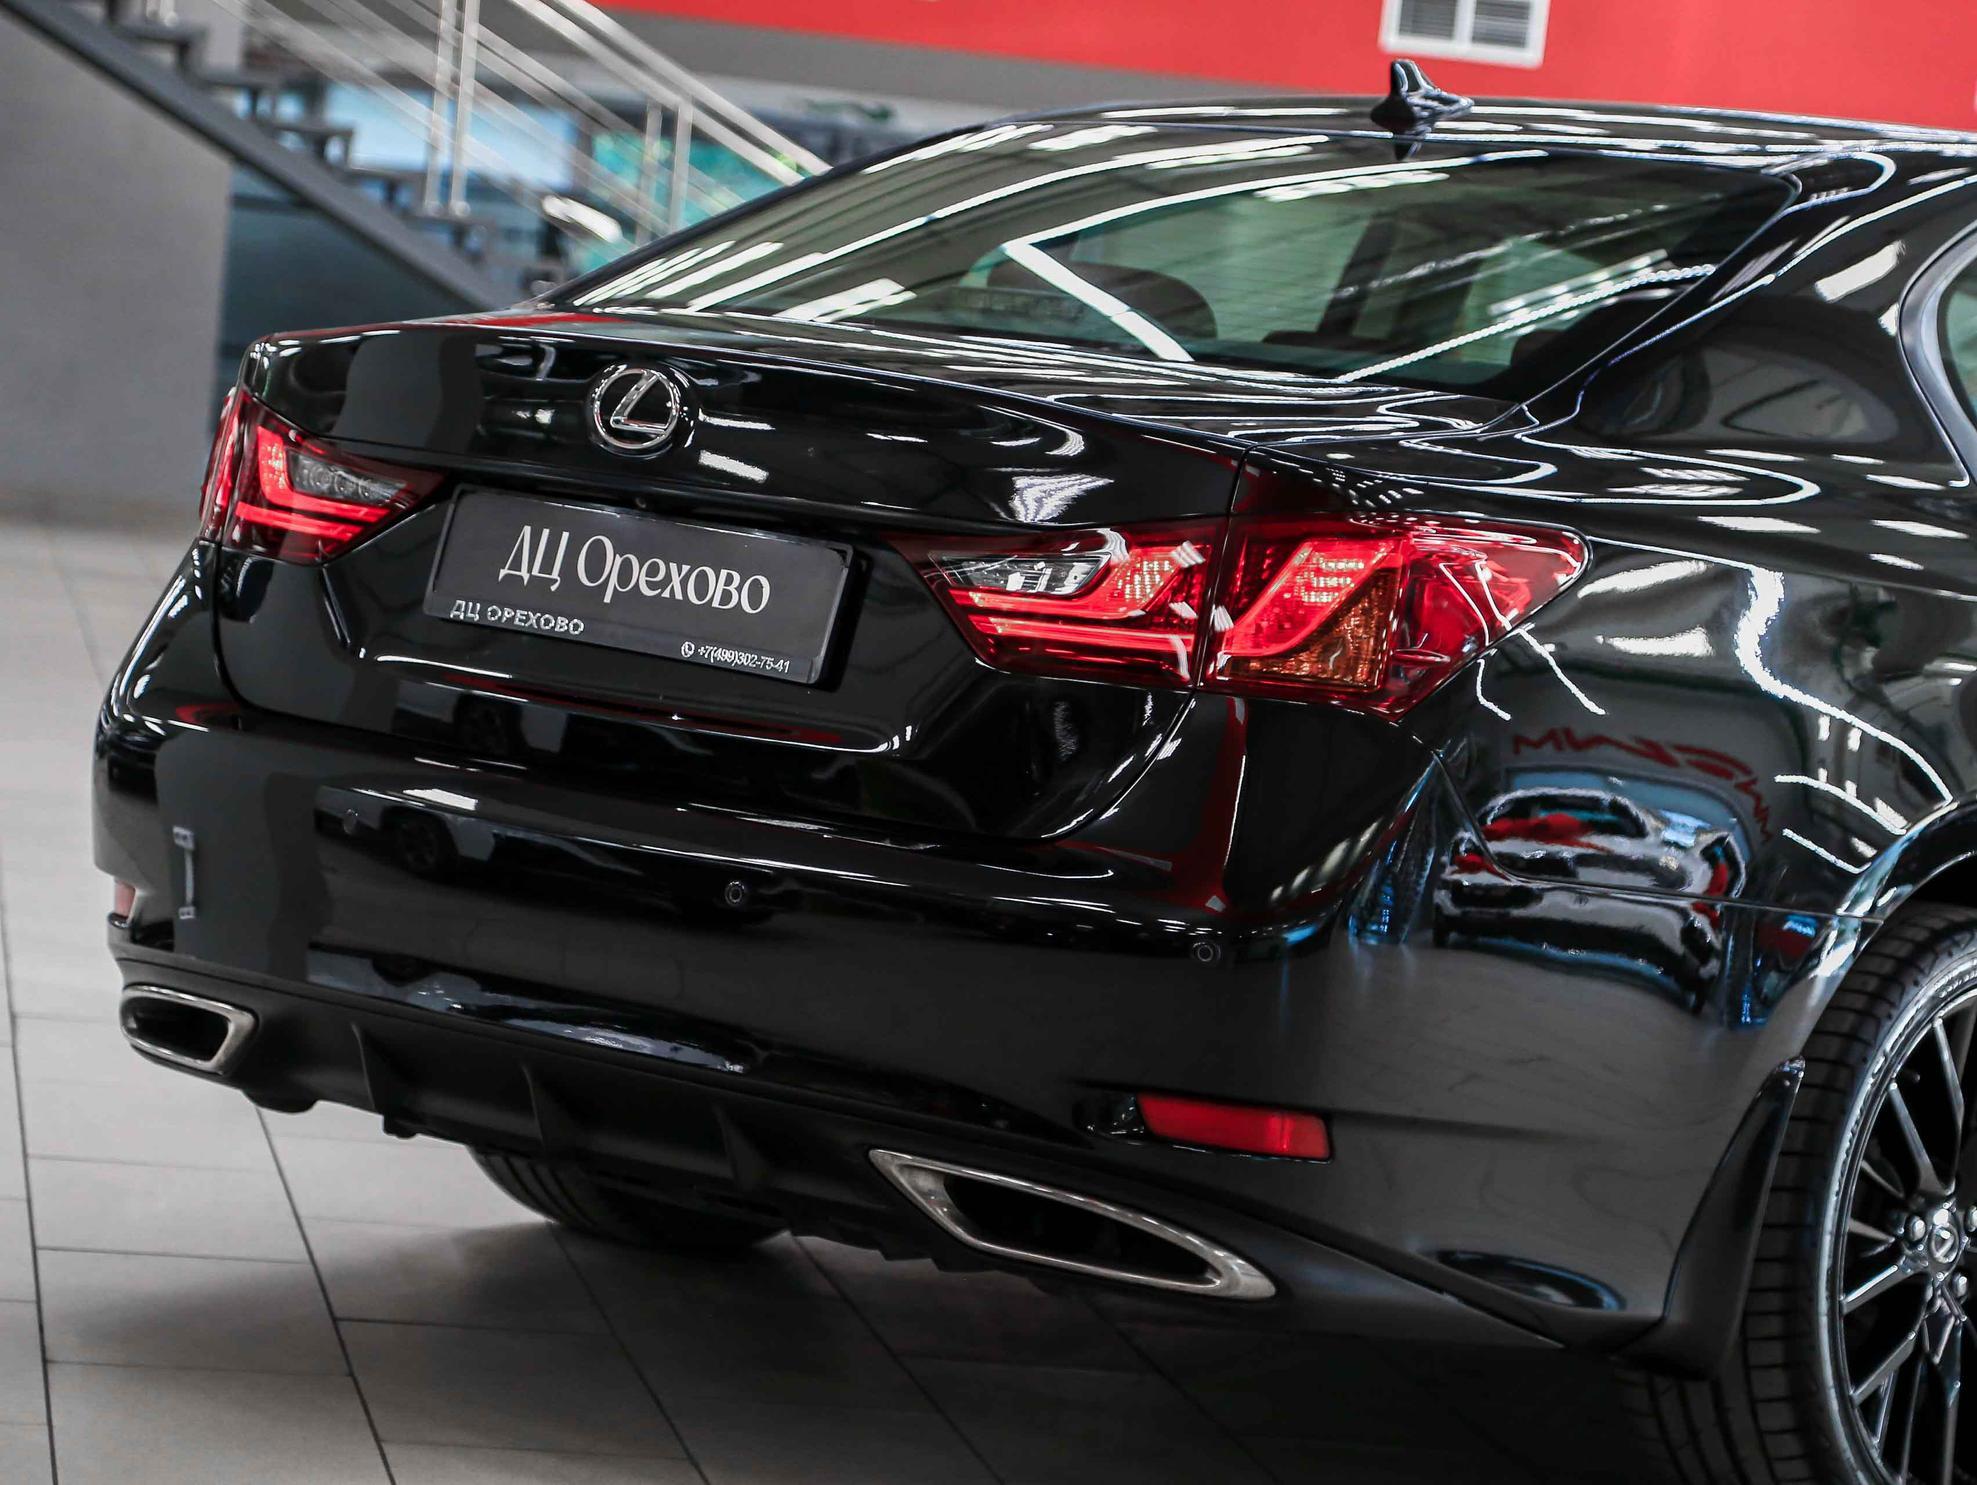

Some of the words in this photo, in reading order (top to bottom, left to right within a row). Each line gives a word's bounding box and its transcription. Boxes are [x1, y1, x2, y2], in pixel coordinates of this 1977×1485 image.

[498, 525, 569, 592] ДЦ
[577, 535, 771, 614] Орехово
[449, 599, 481, 622] ДЦ
[487, 605, 585, 635] ОРЕХОВО
